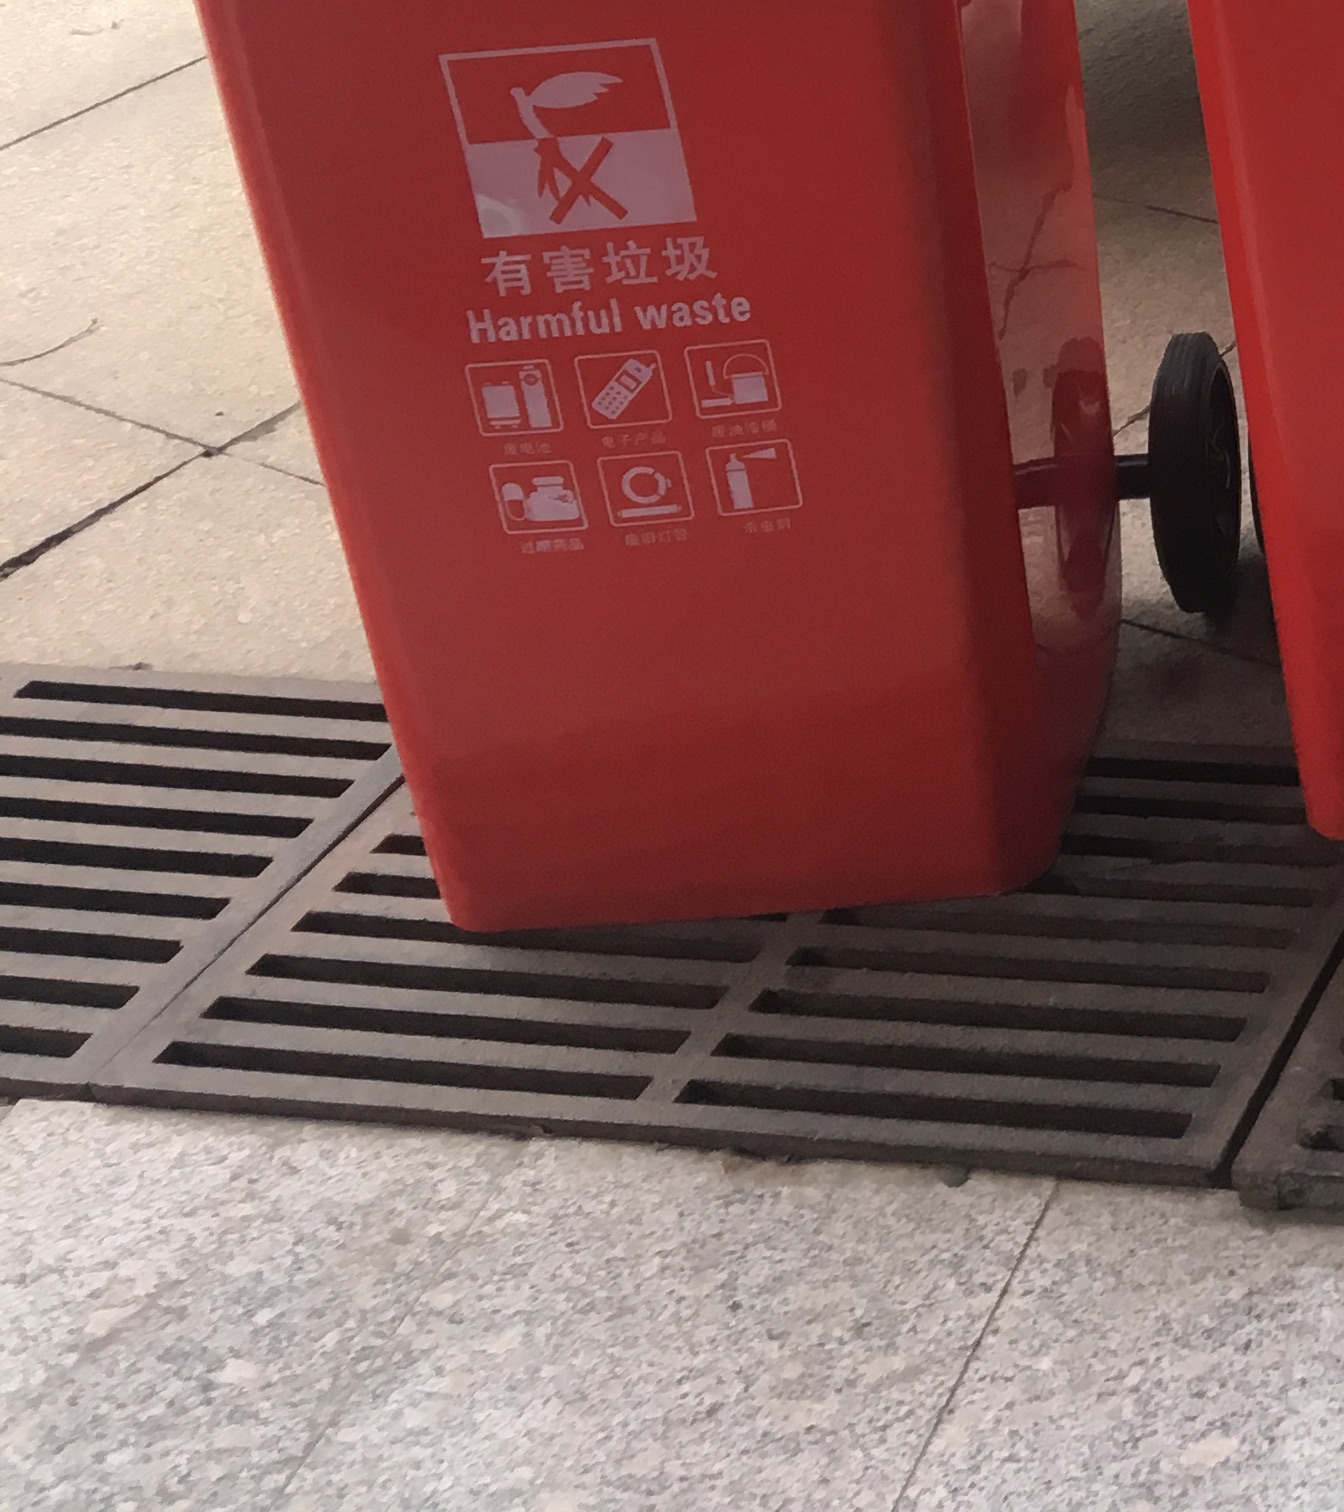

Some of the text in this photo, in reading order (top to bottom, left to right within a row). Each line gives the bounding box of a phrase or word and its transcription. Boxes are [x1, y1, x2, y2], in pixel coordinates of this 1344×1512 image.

[481, 236, 718, 296] 有害垃圾
[466, 293, 751, 343] Harmful waste
[600, 430, 667, 449] 电子产品
